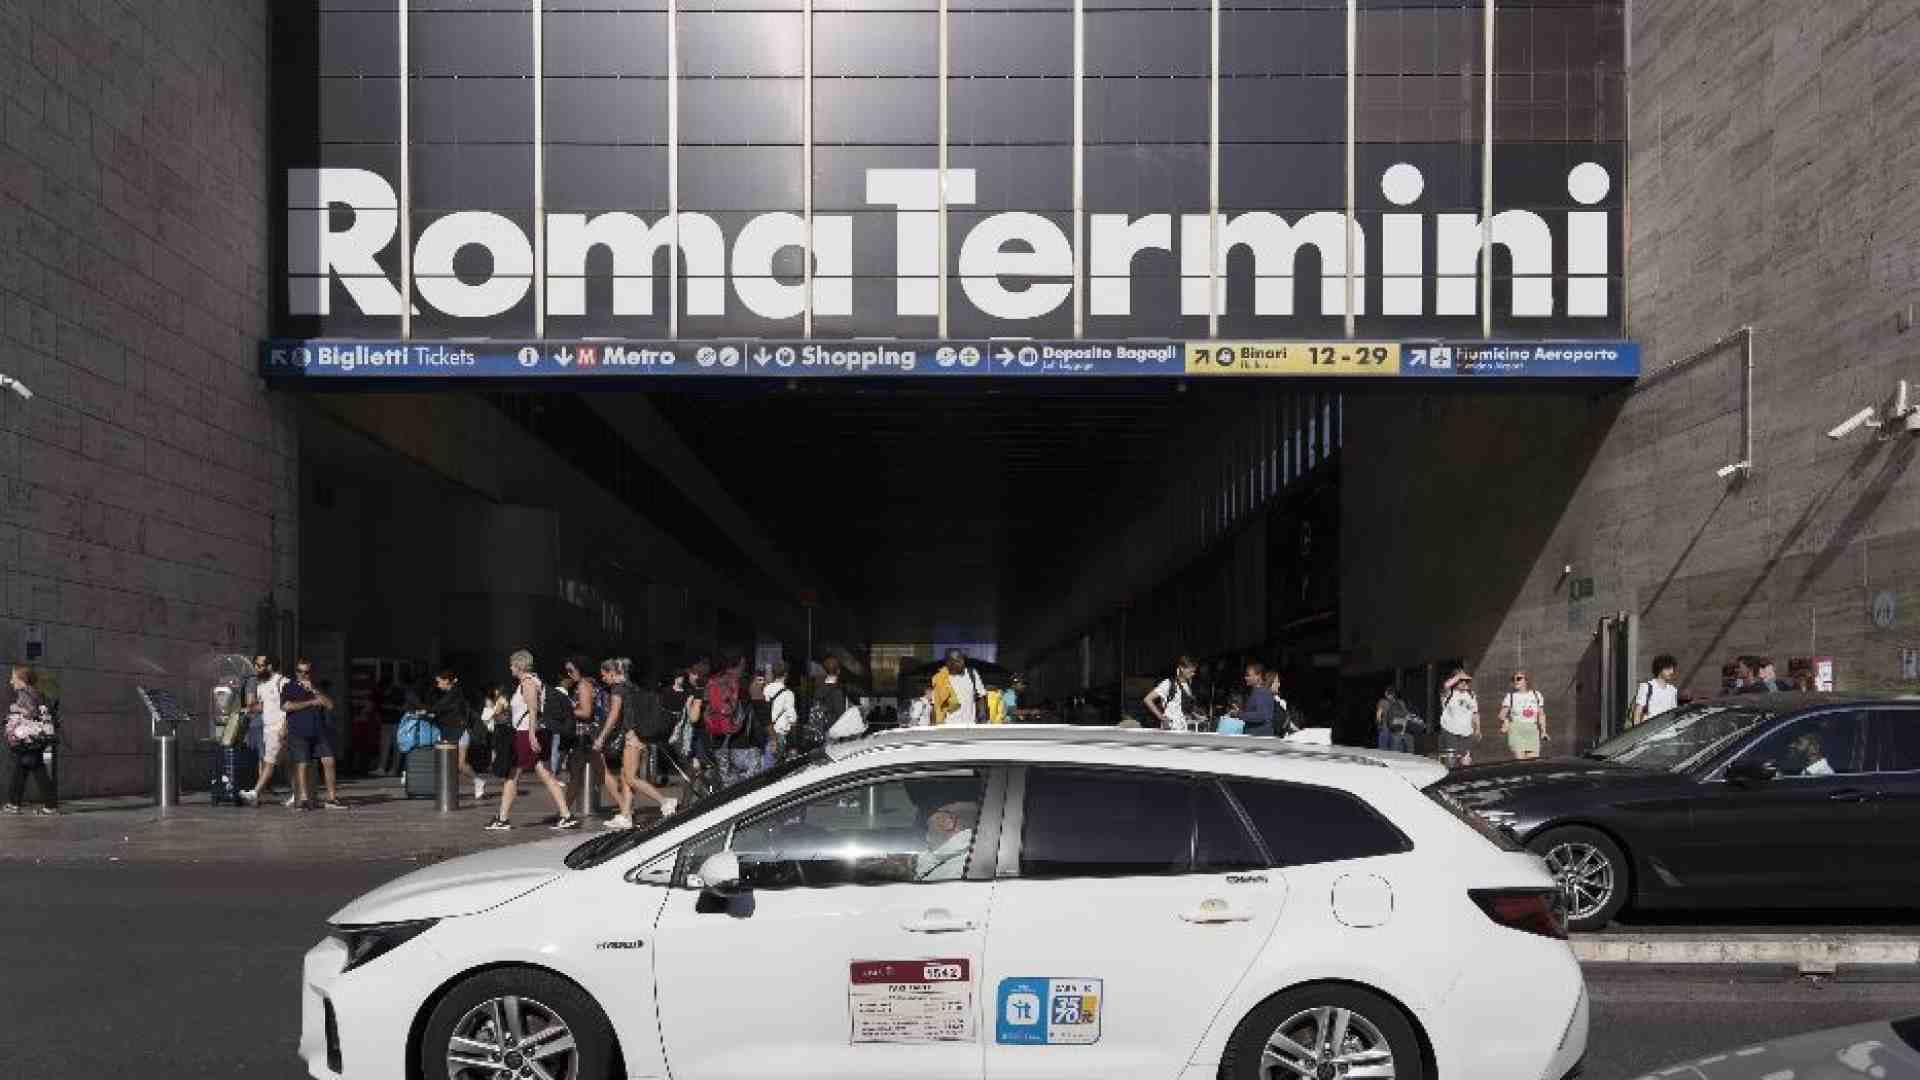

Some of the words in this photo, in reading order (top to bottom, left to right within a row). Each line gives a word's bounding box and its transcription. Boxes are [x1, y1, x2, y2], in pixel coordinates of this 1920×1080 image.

[318, 345, 409, 371] Biglietti
[415, 346, 475, 366] Tickets
[602, 346, 676, 366] Metro
[801, 344, 916, 370] Shopping
[1042, 345, 1112, 362] Deposito
[1116, 345, 1177, 363] Bagagli
[1240, 346, 1287, 360] Binari
[1456, 347, 1530, 361] Fiumicino
[1534, 347, 1618, 363] Aeroporto
